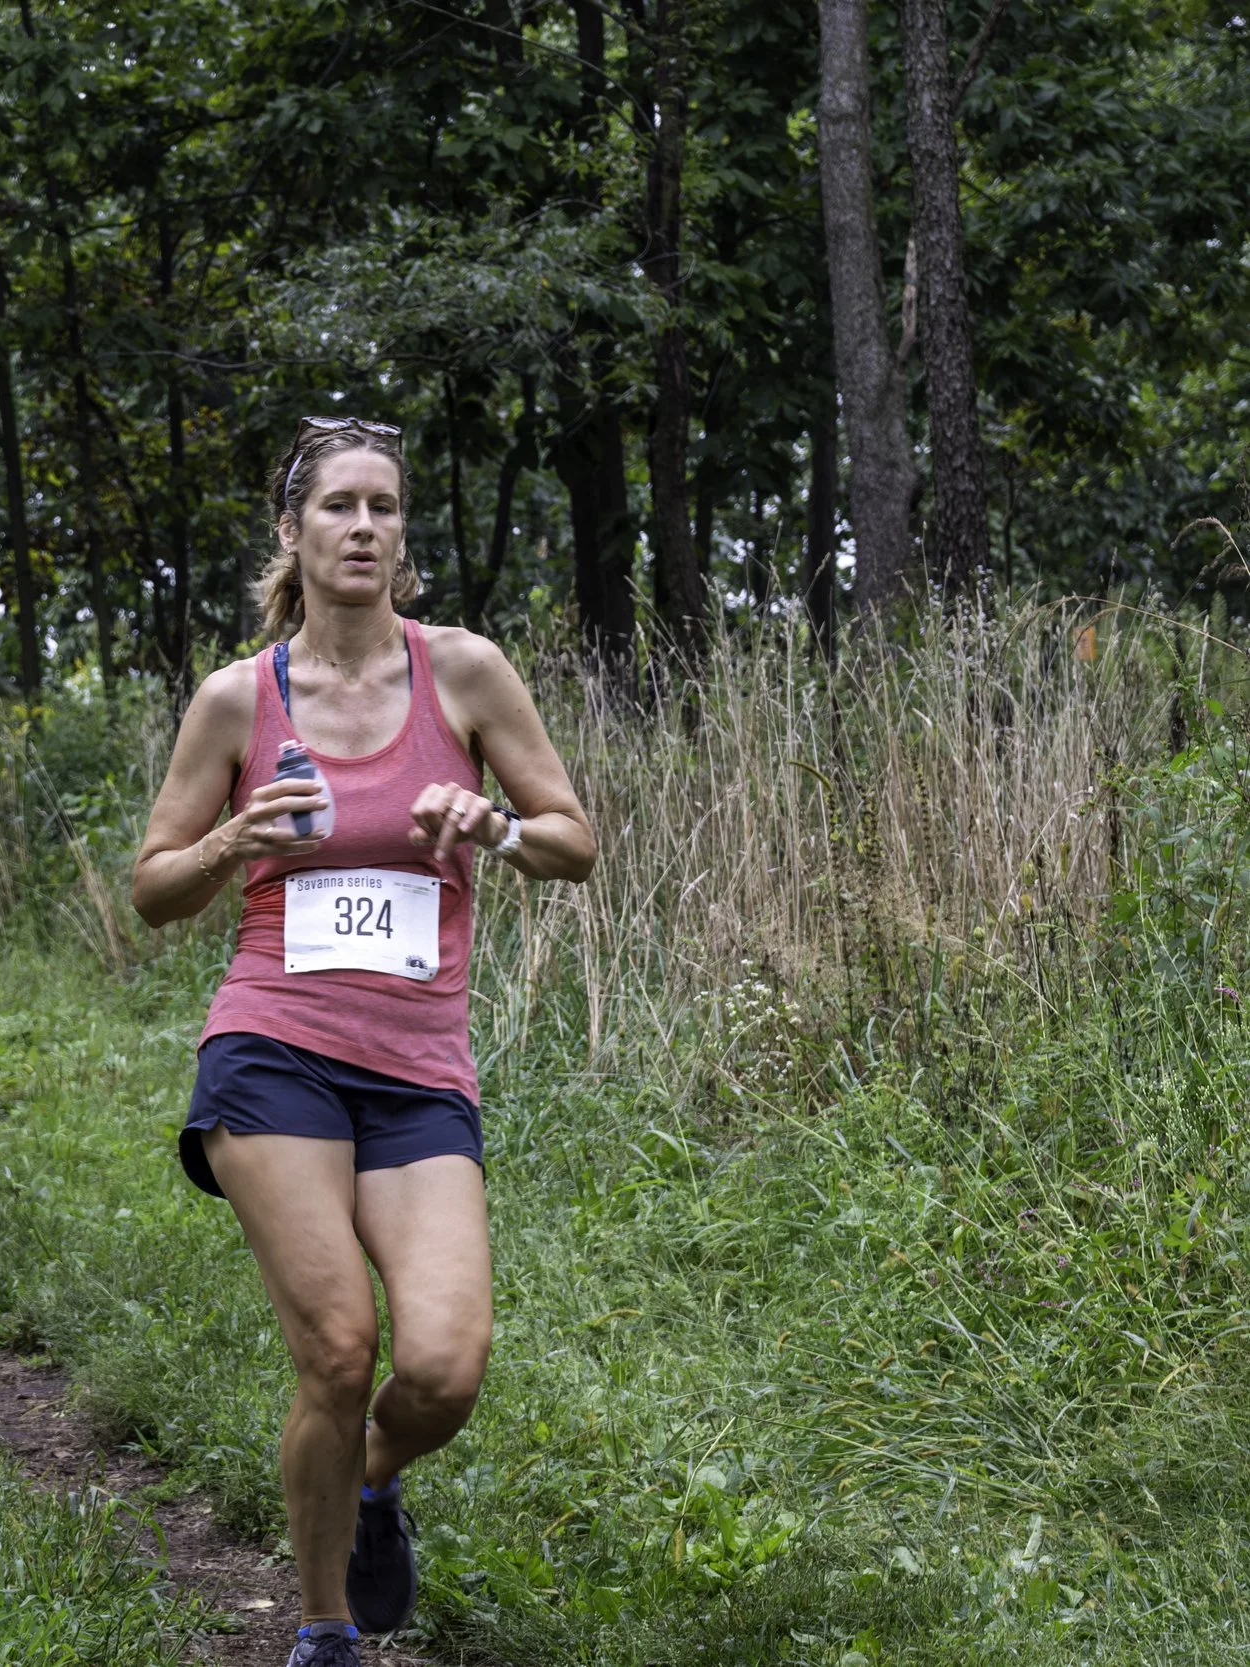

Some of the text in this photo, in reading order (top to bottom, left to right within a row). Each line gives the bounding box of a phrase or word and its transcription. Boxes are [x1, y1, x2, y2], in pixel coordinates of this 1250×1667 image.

[297, 877, 344, 892] Savanna
[347, 876, 383, 889] series
[335, 896, 393, 939] 324
